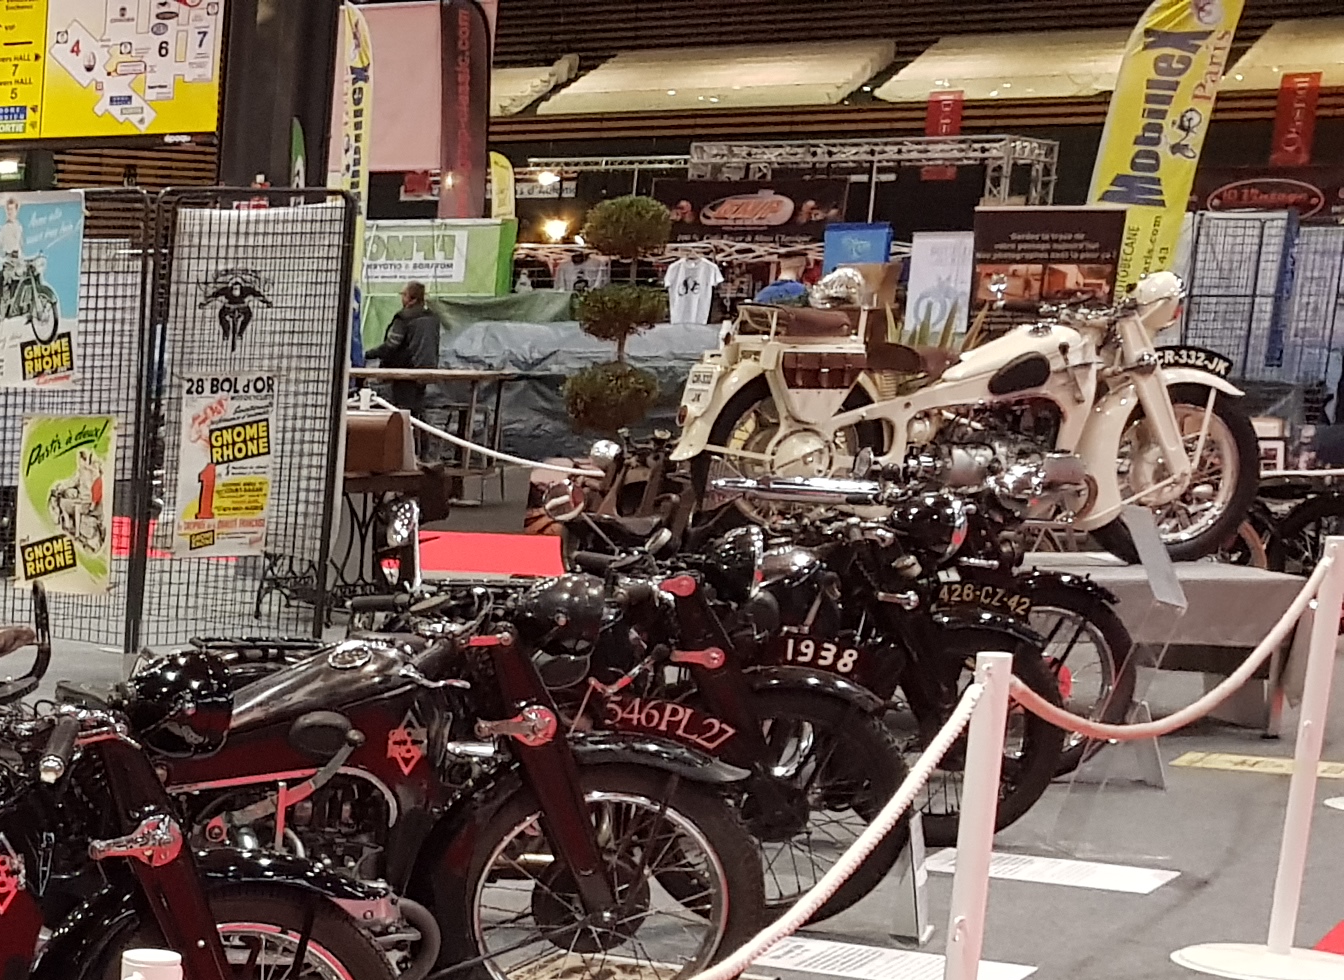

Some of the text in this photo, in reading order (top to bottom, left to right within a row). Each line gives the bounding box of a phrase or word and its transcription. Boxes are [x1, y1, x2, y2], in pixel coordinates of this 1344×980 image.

[70, 39, 81, 57] 4
[197, 31, 208, 48] 7
[13, 54, 31, 62] HALL
[158, 40, 169, 58] 6
[11, 64, 19, 76] 7
[14, 77, 33, 85] HALL
[9, 88, 18, 100] 5
[24, 337, 70, 358] GNOME
[24, 351, 71, 373] RHONE
[210, 377, 240, 395] BOL
[212, 421, 268, 447] GNOME
[212, 437, 269, 464] RHONE
[24, 537, 73, 562] GNOME
[25, 550, 75, 577] RHONE
[785, 638, 859, 674] 1938
